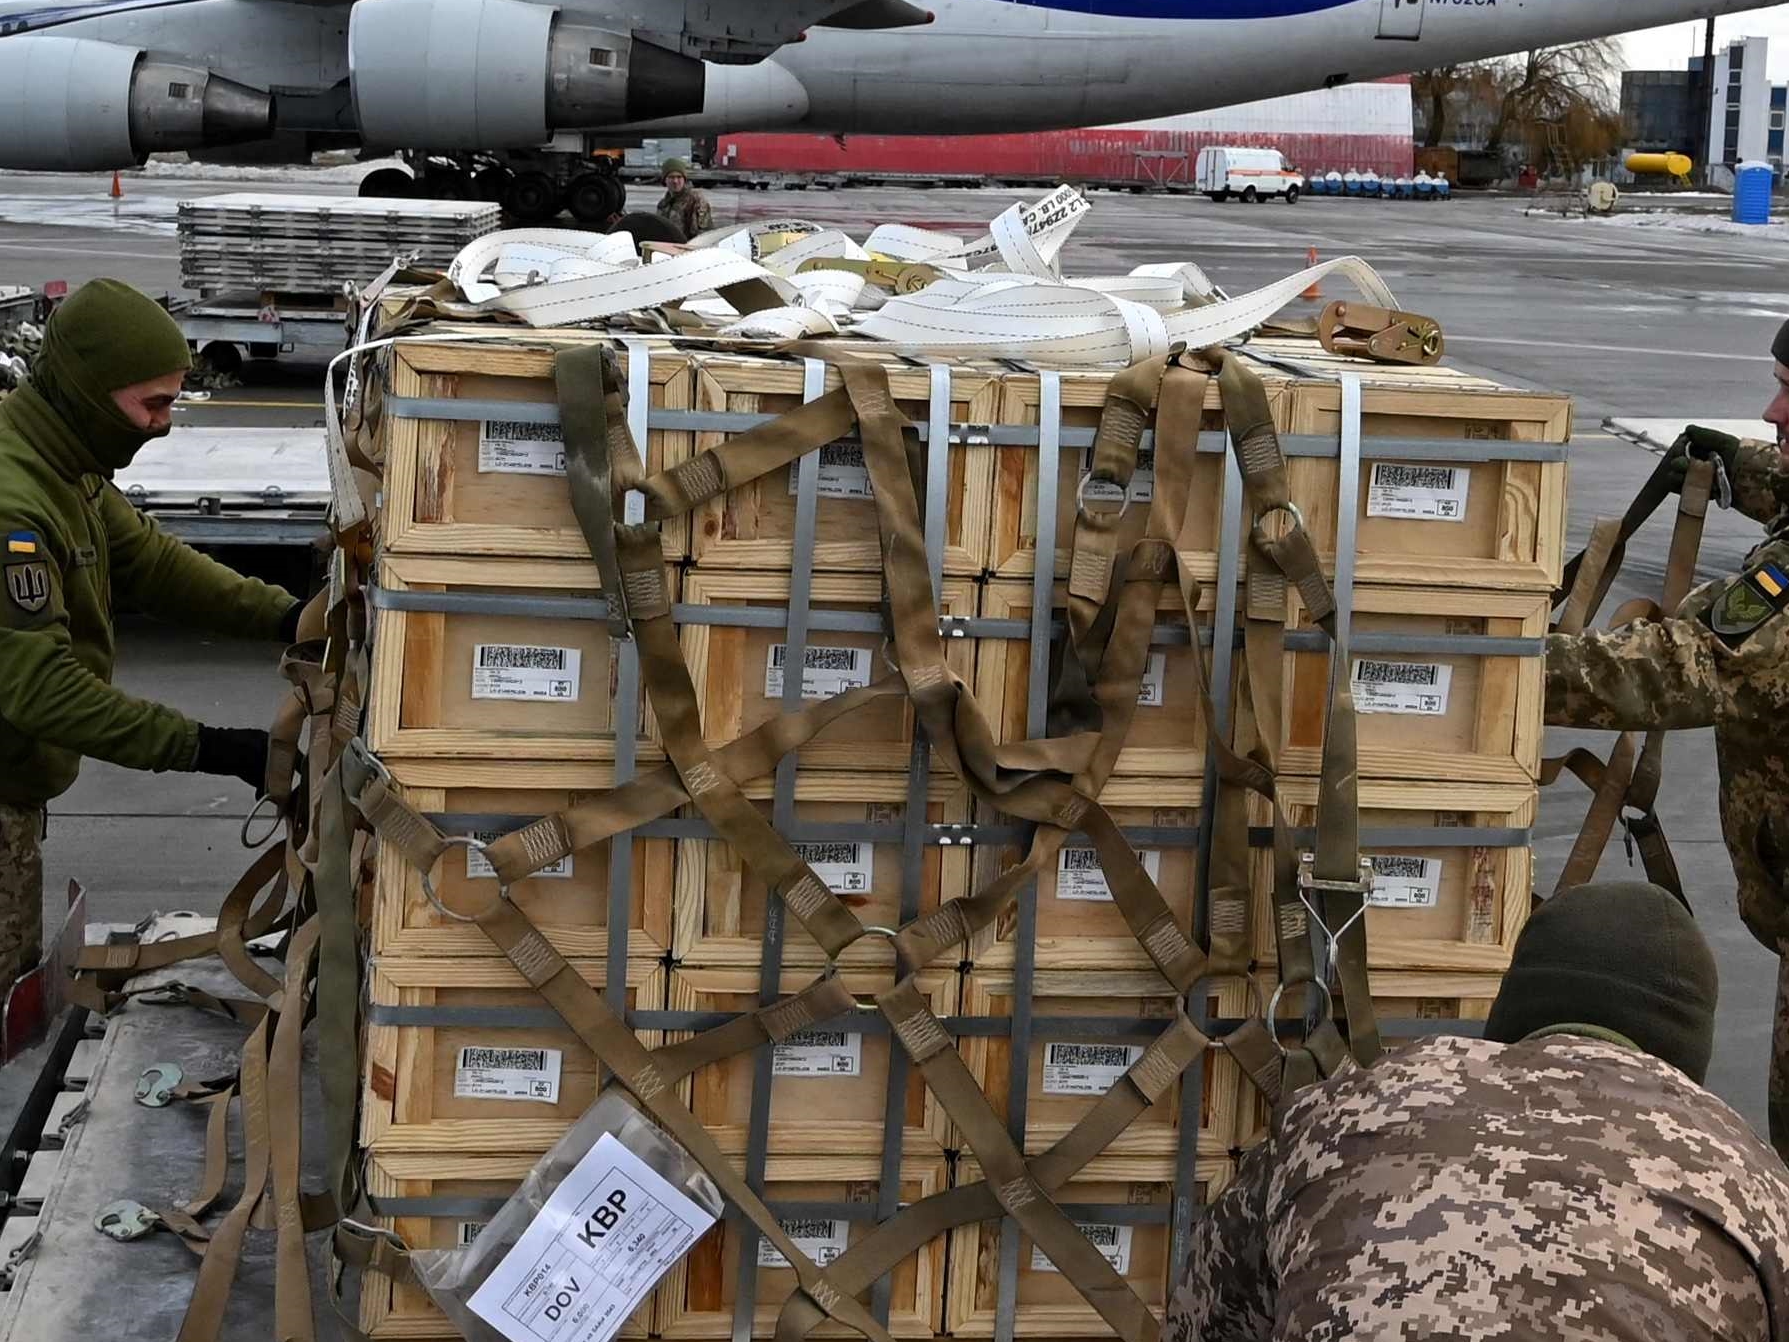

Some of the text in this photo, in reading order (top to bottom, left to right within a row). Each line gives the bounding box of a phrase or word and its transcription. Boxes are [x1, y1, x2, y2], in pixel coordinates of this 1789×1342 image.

[576, 1189, 628, 1249] KBP
[524, 1264, 552, 1297] KBP014
[544, 1277, 581, 1322] DOV
